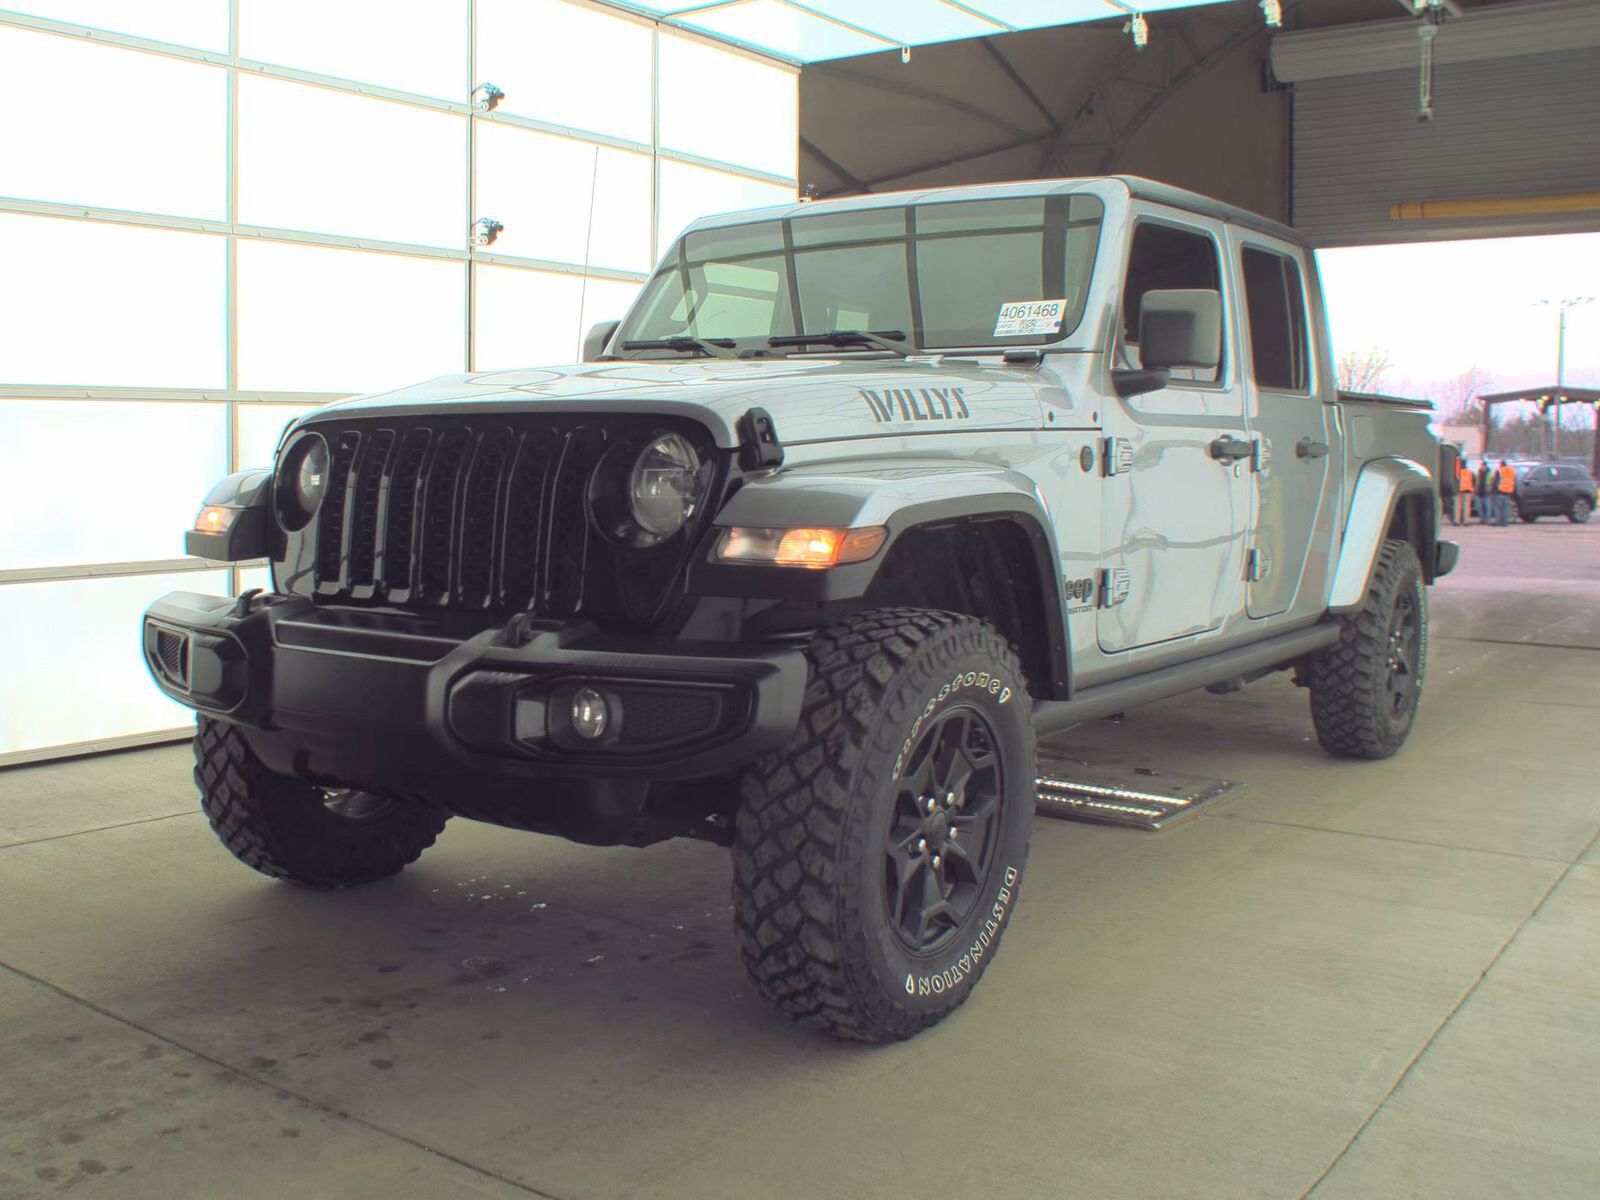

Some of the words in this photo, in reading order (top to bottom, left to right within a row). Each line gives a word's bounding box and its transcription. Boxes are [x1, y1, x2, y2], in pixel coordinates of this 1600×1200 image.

[1000, 303, 1059, 319] 4061468
[858, 387, 969, 423] WILLYS
[918, 866, 1018, 996] DESTINATION
